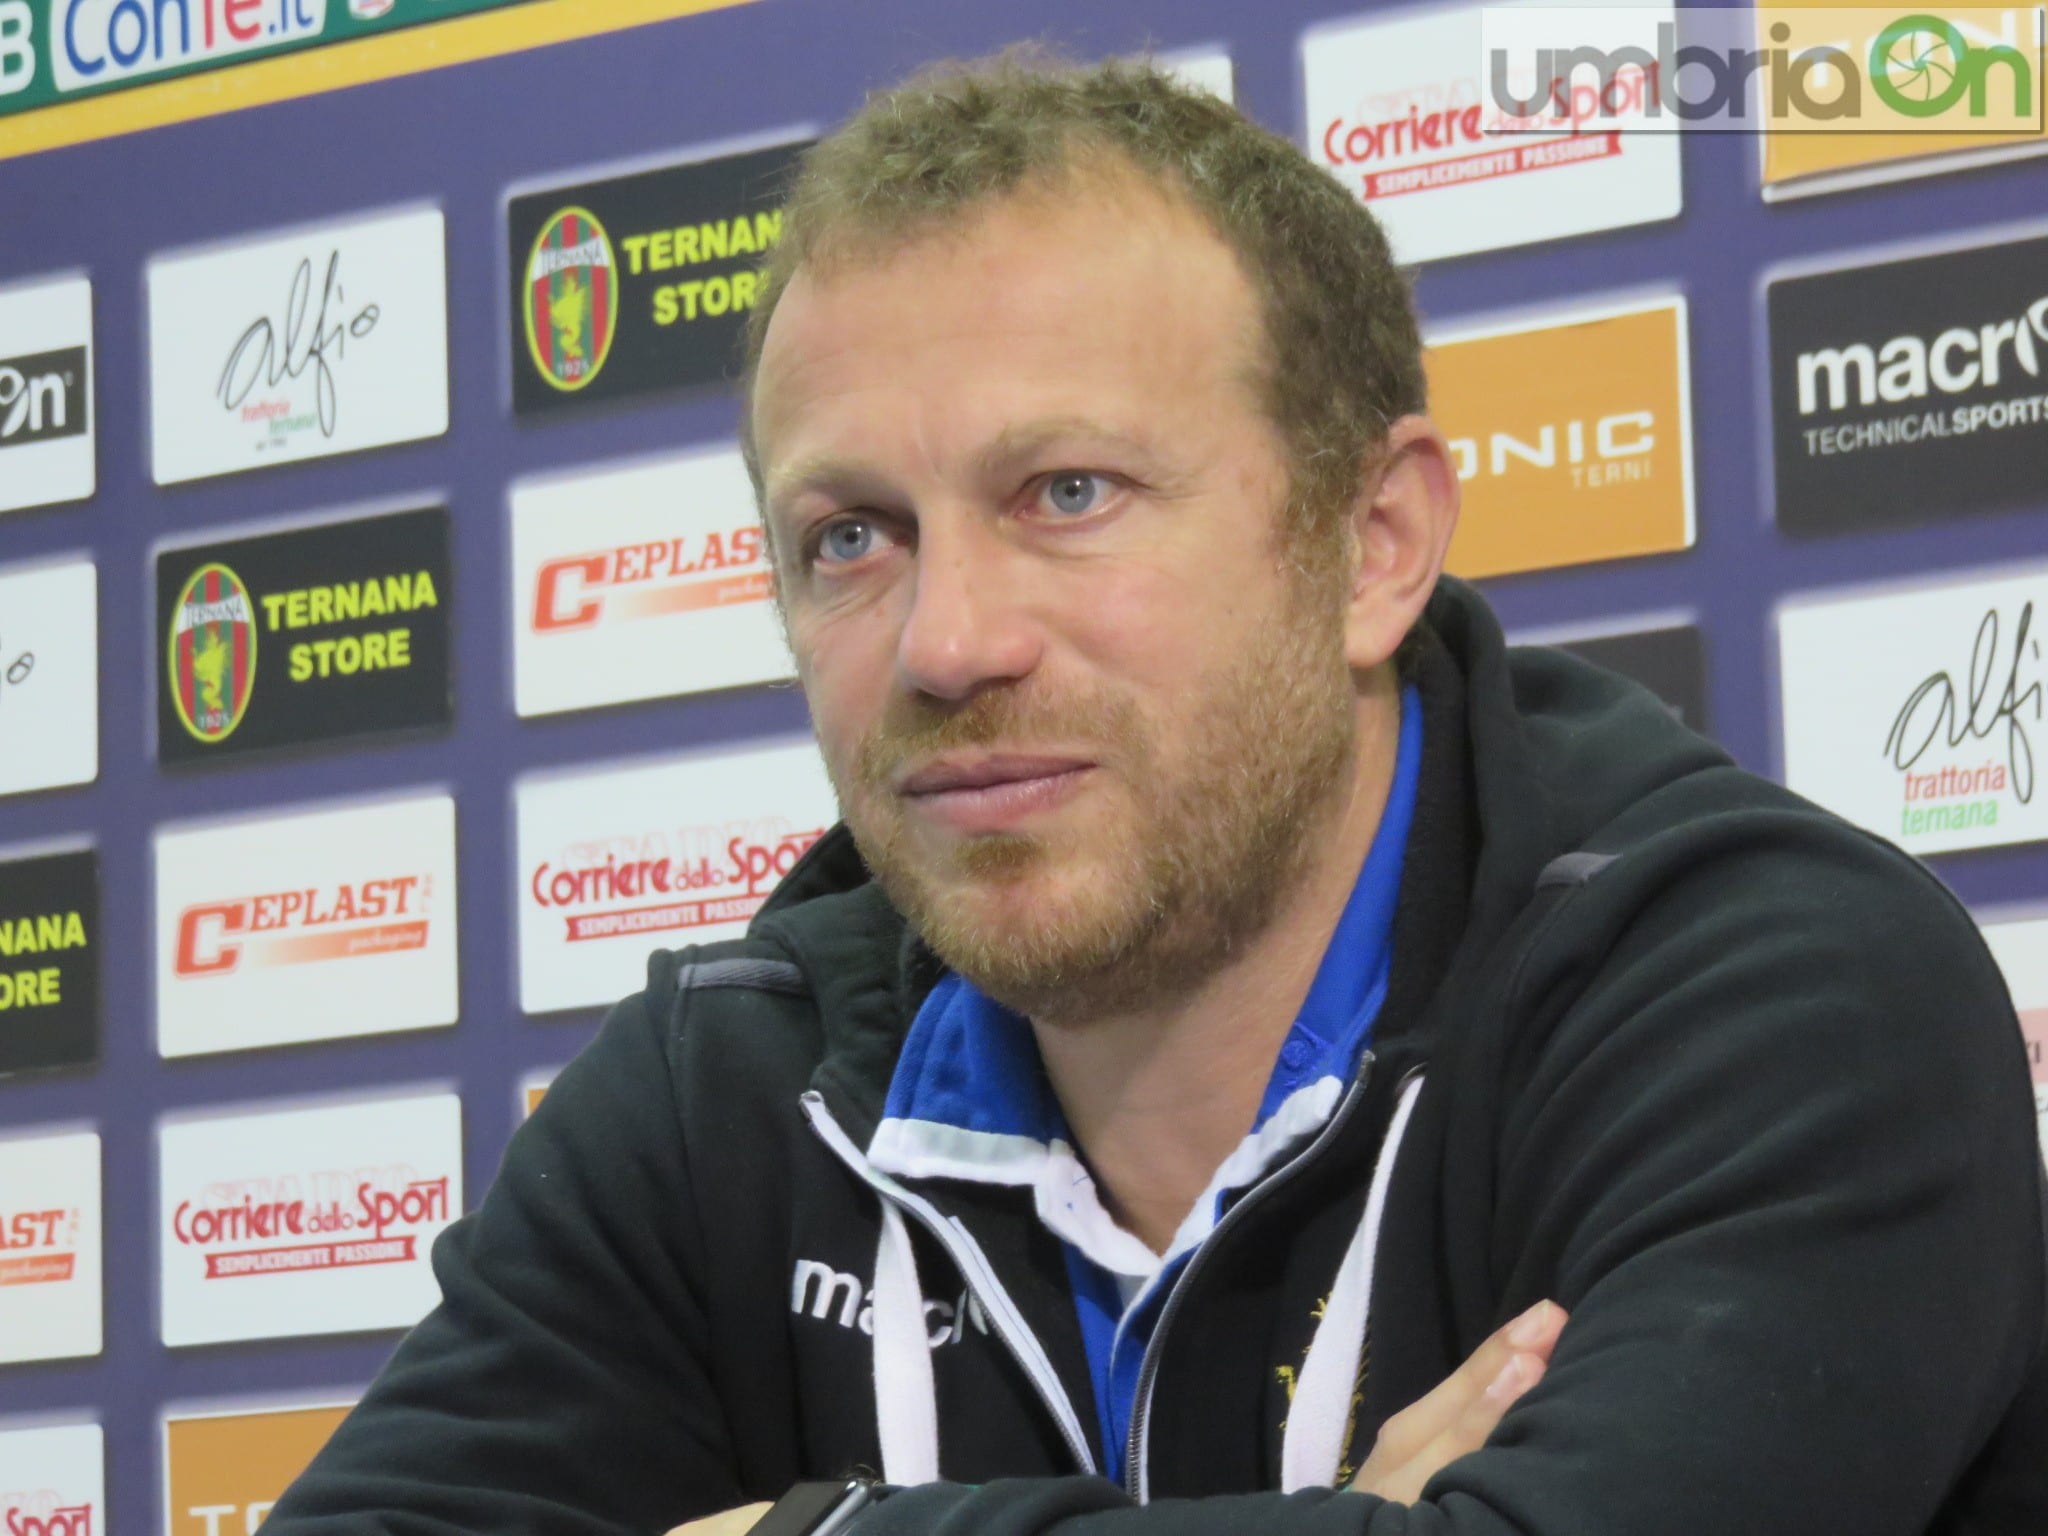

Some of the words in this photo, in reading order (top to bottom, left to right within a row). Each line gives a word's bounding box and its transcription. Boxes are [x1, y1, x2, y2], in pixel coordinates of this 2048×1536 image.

[1324, 103, 1482, 164] Corriere
[1377, 154, 1517, 196] SEMPLICEMENTE
[1523, 136, 1608, 168] PASSIONE
[622, 209, 782, 275] TERNAN
[216, 248, 381, 438] alfio
[1571, 461, 1650, 488] TERNI
[261, 571, 438, 631] TERNANA
[532, 526, 767, 631] CEPLAS
[289, 629, 411, 682] STORE
[1903, 761, 2007, 802] trattoria
[1899, 800, 1998, 837] ternana
[532, 852, 671, 908] Corriere
[175, 875, 418, 978] CEPLAST
[577, 903, 699, 936] SEMPLICEMENTE
[174, 1194, 302, 1244] Corriere
[306, 1202, 354, 1233] dello
[356, 1176, 449, 1240] Sport
[216, 1247, 330, 1274] SEMPLICEMENTE
[335, 1240, 405, 1262] PASSIONE
